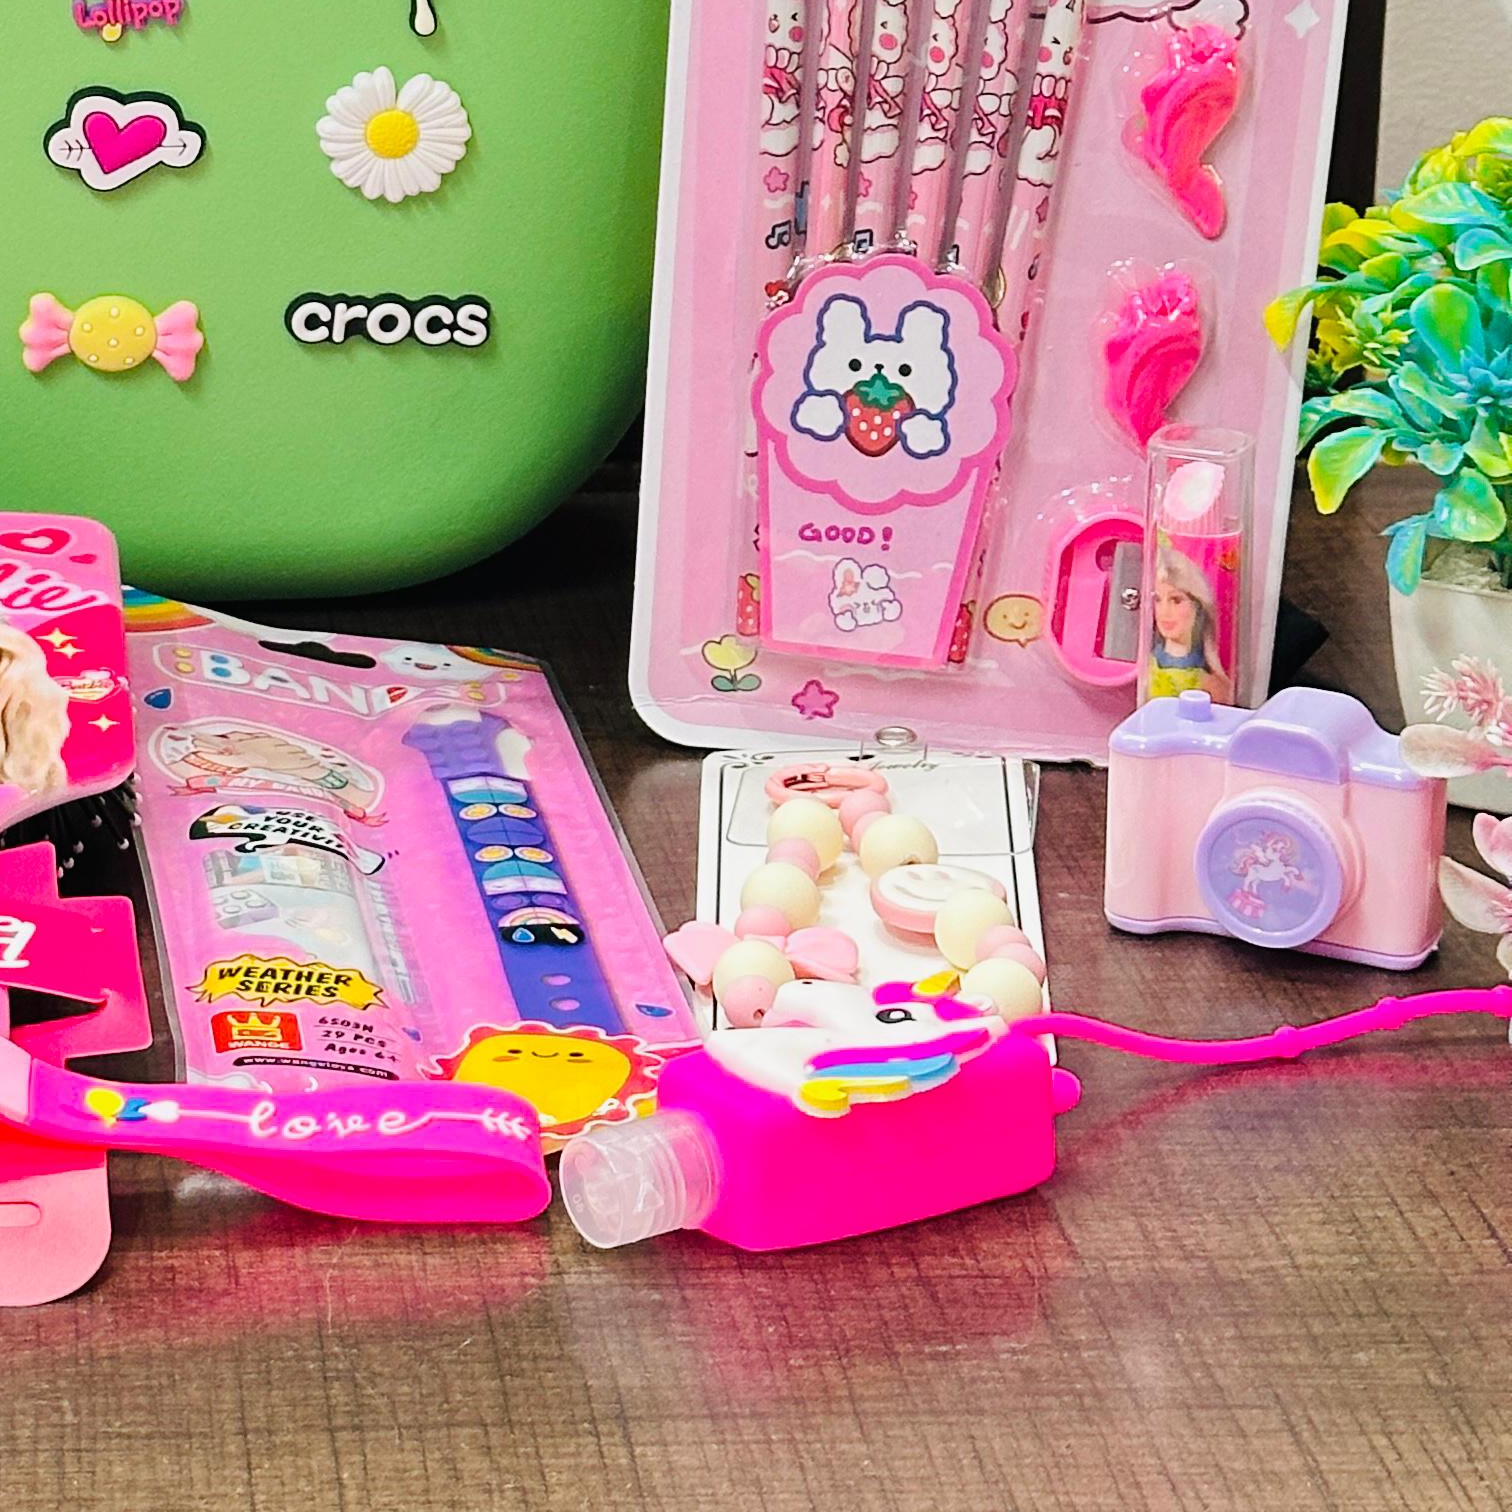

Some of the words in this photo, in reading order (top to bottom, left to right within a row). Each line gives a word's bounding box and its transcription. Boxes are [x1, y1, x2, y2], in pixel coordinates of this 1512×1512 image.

[291, 301, 489, 346] crocs
[264, 815, 325, 834] YOUR
[276, 811, 316, 822] USE
[218, 965, 353, 988] WEATHER
[236, 979, 339, 998] SERIES
